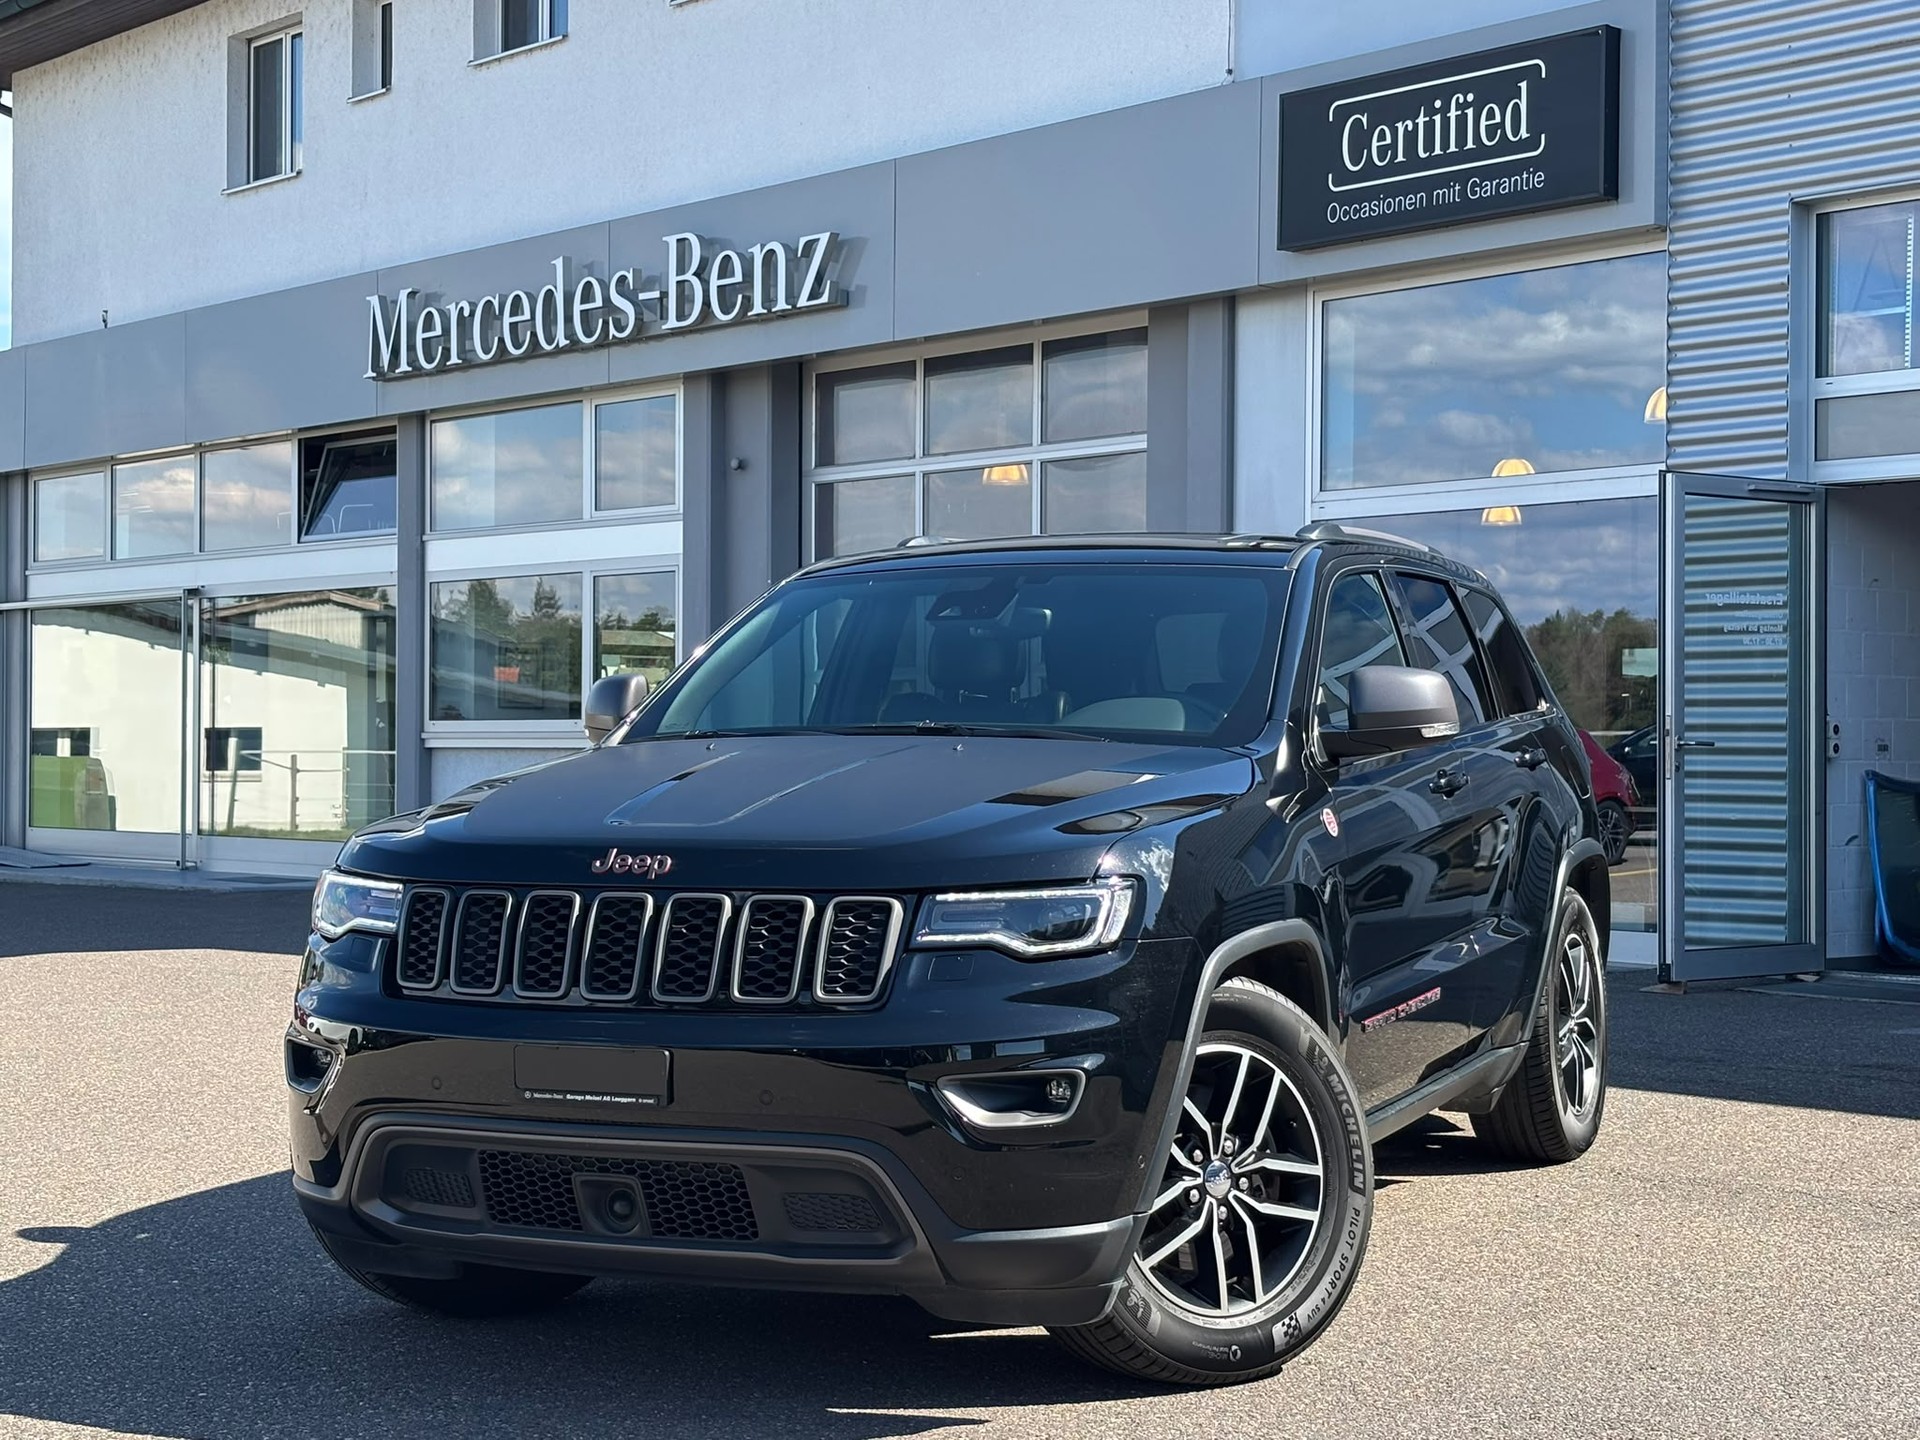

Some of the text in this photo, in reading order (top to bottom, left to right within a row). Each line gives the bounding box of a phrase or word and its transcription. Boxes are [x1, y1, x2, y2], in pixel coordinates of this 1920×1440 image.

[1341, 79, 1531, 172] Certified
[1327, 168, 1545, 224] Occasionen mit Garantie
[363, 231, 840, 379] Mercedes-Benz
[591, 847, 672, 880] Jeep
[1328, 1072, 1365, 1189] MICHELIN
[1306, 1207, 1361, 1323] PILOT SPORT 4 SUV
